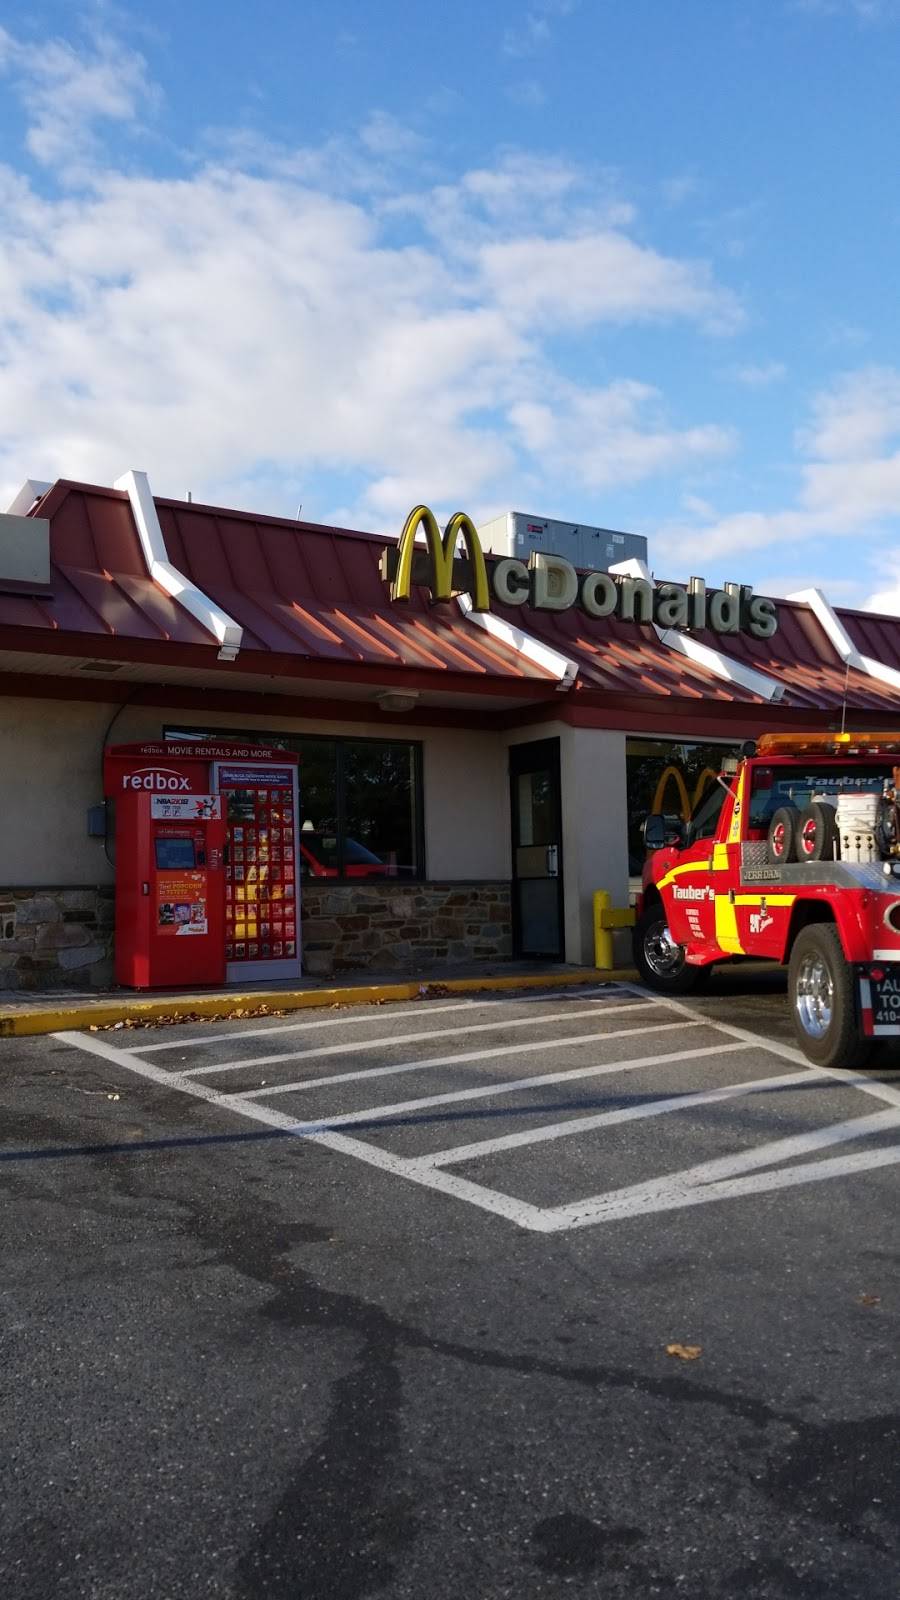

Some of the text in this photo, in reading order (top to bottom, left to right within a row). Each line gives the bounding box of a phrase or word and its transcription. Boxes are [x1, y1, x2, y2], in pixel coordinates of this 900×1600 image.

[391, 504, 778, 638] McDonald's
[168, 747, 192, 755] MOVIE
[195, 748, 230, 757] RENTALS
[232, 749, 249, 757] AND
[250, 750, 273, 758] MORE
[123, 772, 191, 790] redbox
[672, 885, 715, 901] Tauber's
[879, 995, 900, 1008] TO
